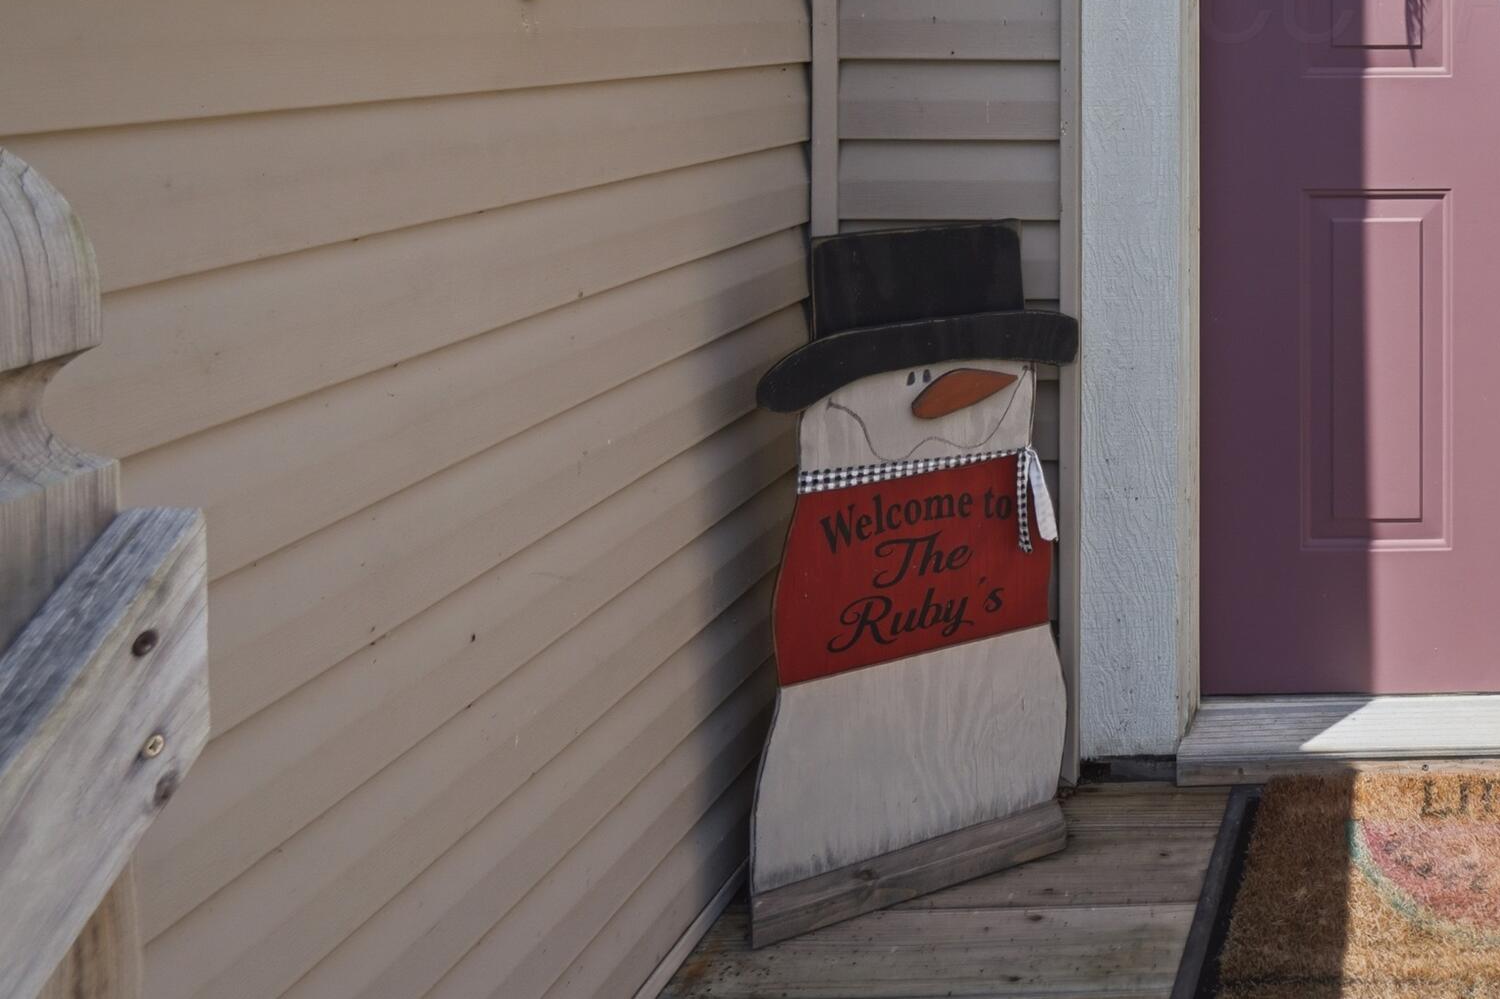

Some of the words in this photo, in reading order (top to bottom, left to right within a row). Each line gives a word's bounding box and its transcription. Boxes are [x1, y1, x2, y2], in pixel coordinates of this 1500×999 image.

[820, 493, 974, 554] Welcome
[983, 487, 1012, 521] to
[873, 530, 974, 589] The
[826, 576, 1004, 653] Ruby's
